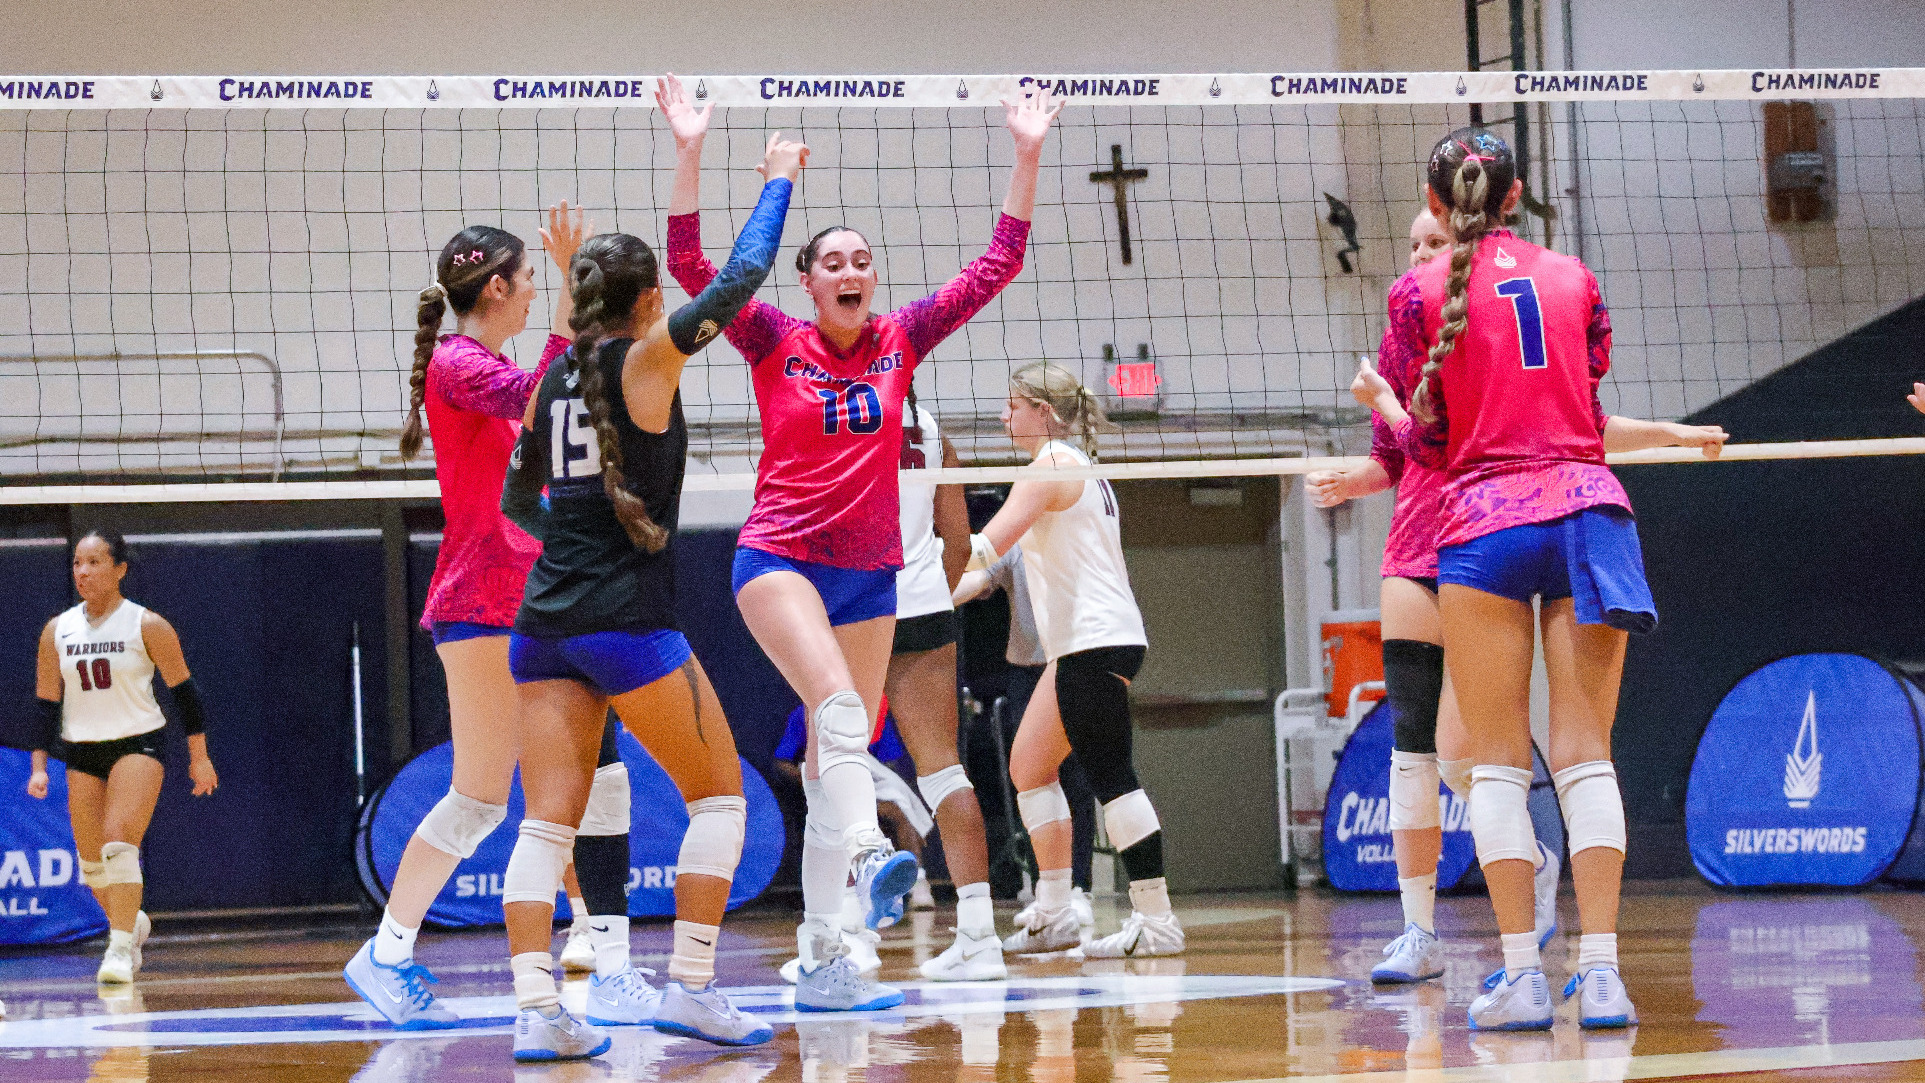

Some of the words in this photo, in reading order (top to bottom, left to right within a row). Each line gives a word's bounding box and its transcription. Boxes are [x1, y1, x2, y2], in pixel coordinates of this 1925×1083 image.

[218, 78, 373, 101] CHAMINADE
[493, 78, 643, 101] CHAMINADE
[759, 77, 906, 100] CHAMINADE
[1270, 75, 1407, 98] CHAMINADE
[1514, 73, 1648, 95] CHAMINADE
[1751, 71, 1881, 93] CHAMINADE
[1493, 276, 1548, 370] 1
[784, 351, 903, 383] CHAADE
[817, 381, 884, 435] 10
[550, 398, 603, 479] 15
[66, 640, 125, 657] WARRIORS
[76, 657, 112, 692] 10
[1724, 826, 1868, 854] SILVERSWORDS
